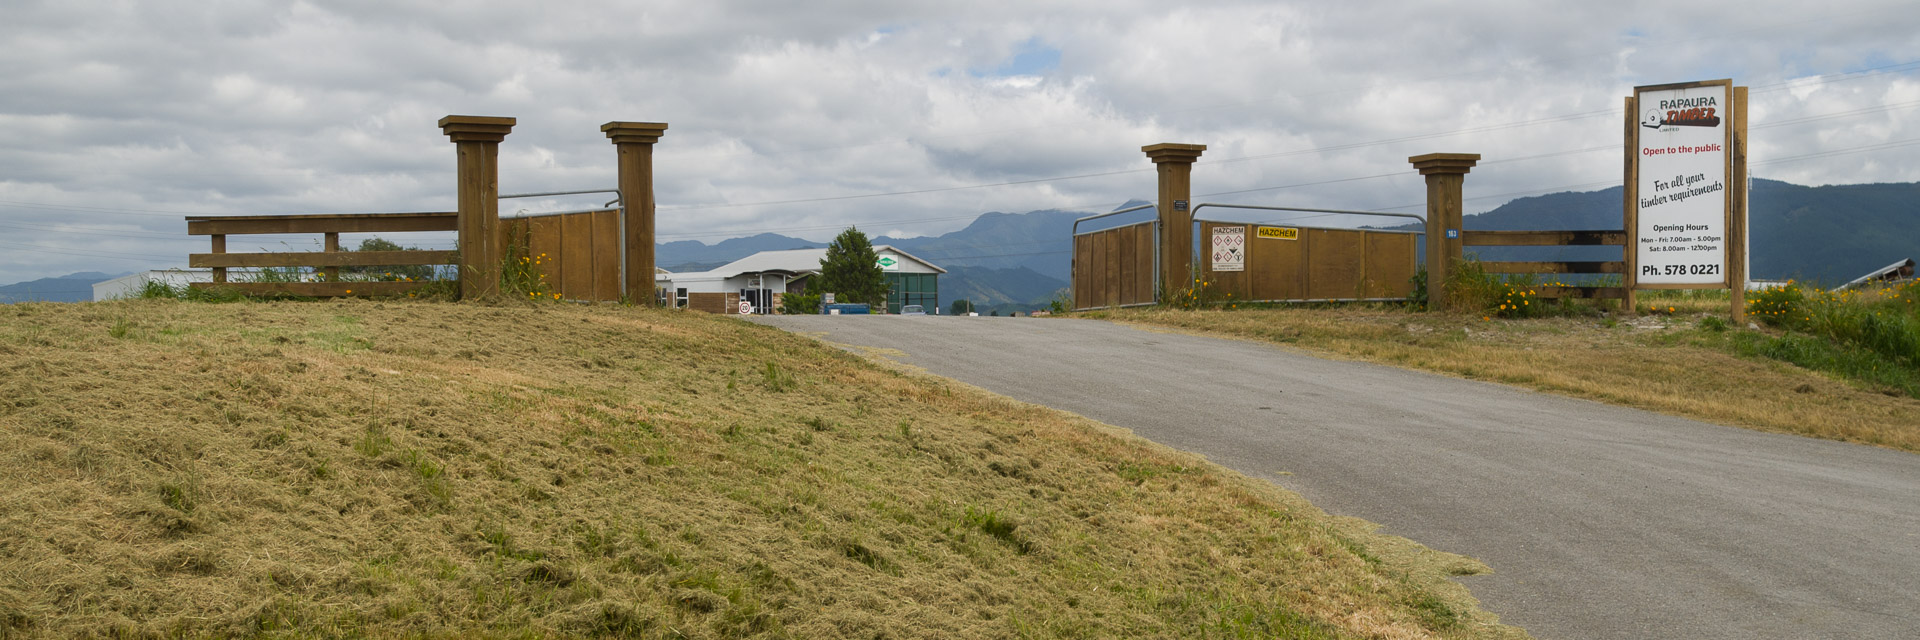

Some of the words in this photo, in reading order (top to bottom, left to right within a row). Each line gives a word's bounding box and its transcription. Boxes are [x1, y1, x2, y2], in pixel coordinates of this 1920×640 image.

[1660, 96, 1717, 110] RAPAURA
[1666, 107, 1716, 123] TIMBER
[1643, 147, 1665, 157] Open
[1667, 146, 1677, 154] to
[1678, 145, 1693, 153] the
[1695, 143, 1721, 154] public
[1654, 180, 1669, 192] For
[1671, 174, 1684, 187] all
[1685, 172, 1705, 187] your
[1640, 194, 1668, 209] timber
[1669, 180, 1723, 202] requirements
[1258, 228, 1297, 238] HAZCHEM
[1653, 224, 1684, 233] Opening
[1686, 223, 1709, 231] Hours
[1642, 265, 1661, 276] Ph.
[1664, 264, 1687, 275] 578
[1690, 263, 1720, 275] 0221
